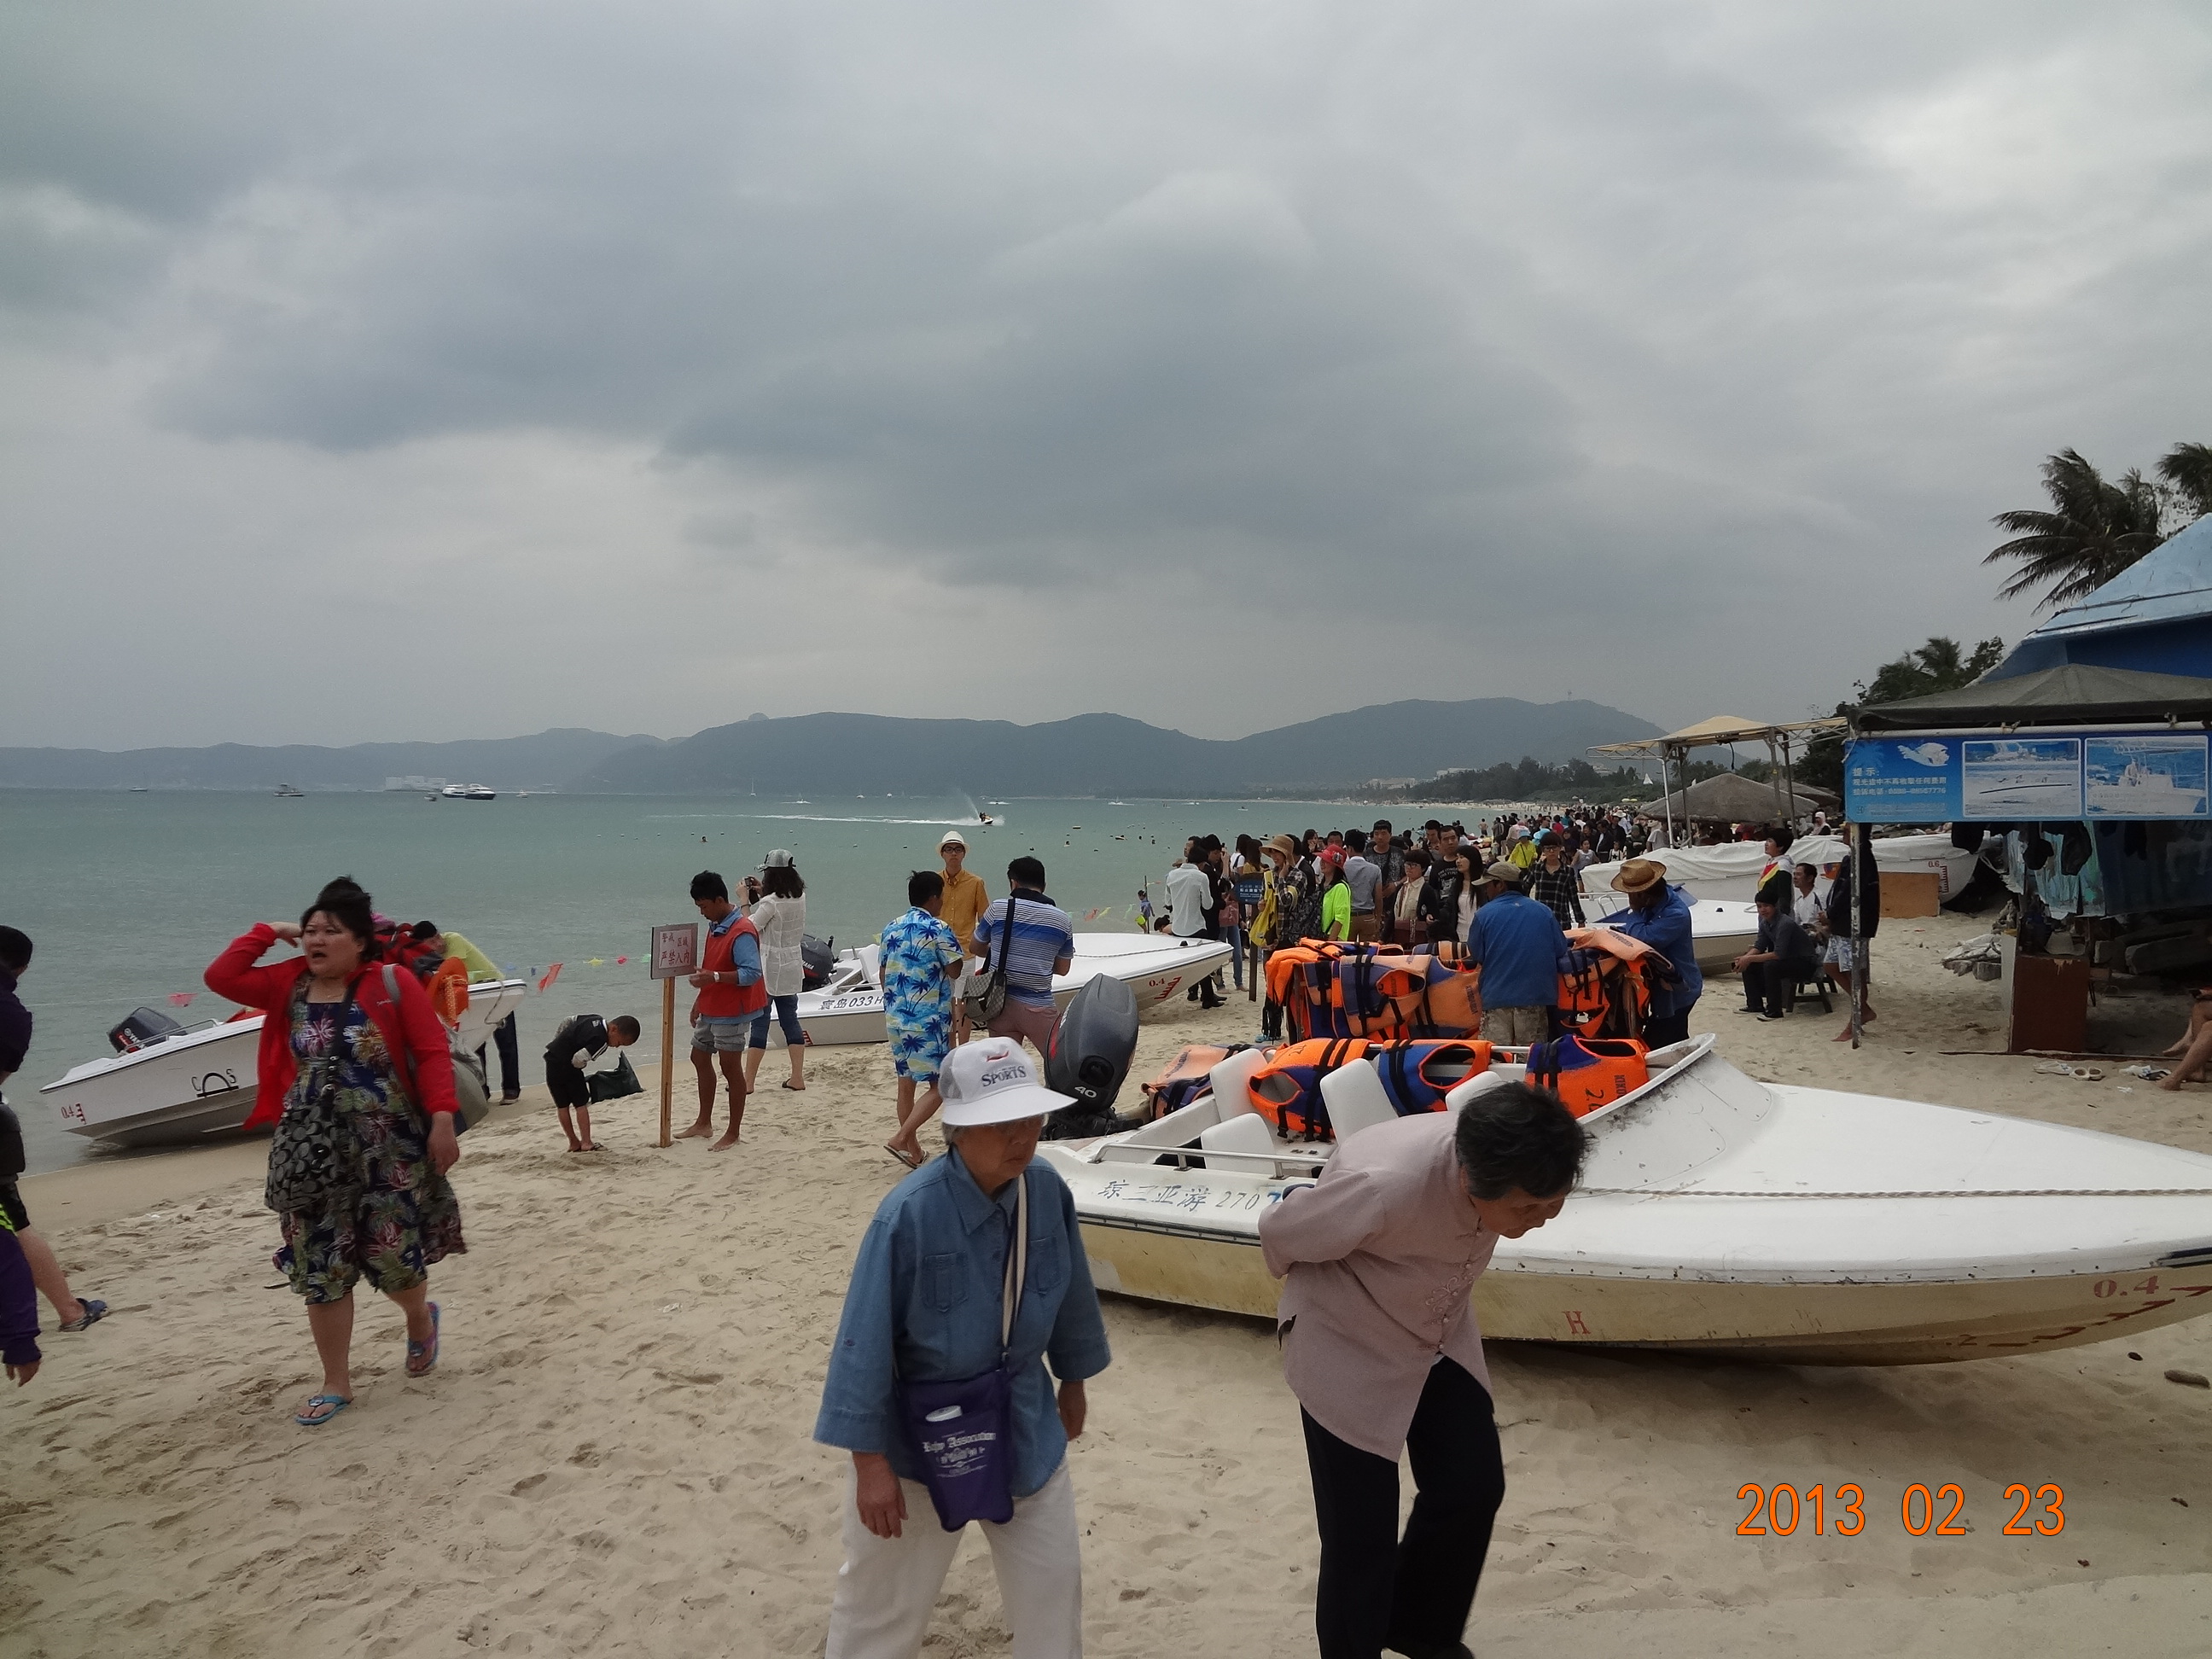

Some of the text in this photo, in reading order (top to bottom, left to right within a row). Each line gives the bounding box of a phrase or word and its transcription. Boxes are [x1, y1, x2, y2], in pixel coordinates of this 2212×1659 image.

[1149, 977, 1166, 987] 0.4
[981, 1066, 1027, 1087] SPORTS
[1074, 1086, 1097, 1098] 40
[2093, 1275, 2159, 1299] 0.4
[1562, 1311, 1591, 1335] H
